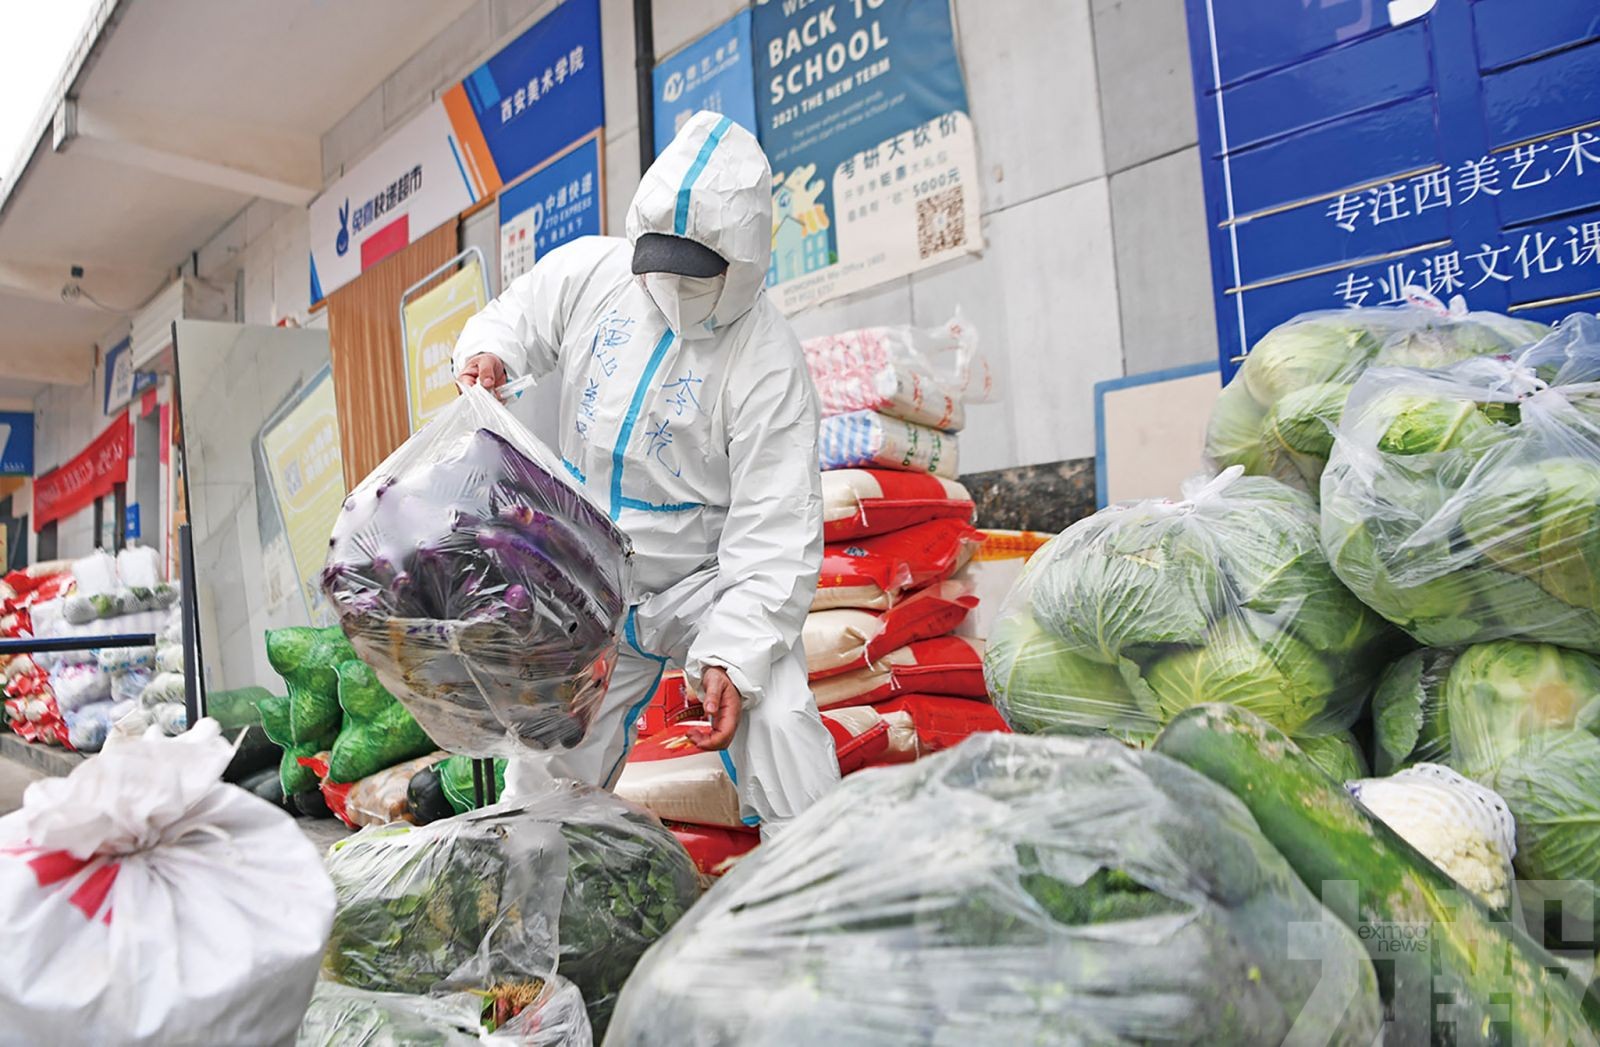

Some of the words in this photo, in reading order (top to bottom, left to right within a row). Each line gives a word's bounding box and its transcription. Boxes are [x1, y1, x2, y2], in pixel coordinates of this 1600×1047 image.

[768, 4, 837, 68] BACK
[770, 20, 888, 105] SCHOOL
[501, 45, 584, 124] 西安美术学院
[772, 105, 799, 129] 2021
[801, 92, 824, 113] THE
[826, 77, 853, 101] NEW
[855, 57, 891, 86] TERM
[840, 112, 958, 179] 考研大砍价
[545, 172, 592, 214] 中通快递
[560, 196, 592, 221] EXPRESS
[913, 168, 960, 197] 5000元
[1325, 131, 1600, 232] 专注西美艺术
[1334, 221, 1600, 308] 专业课文化课
